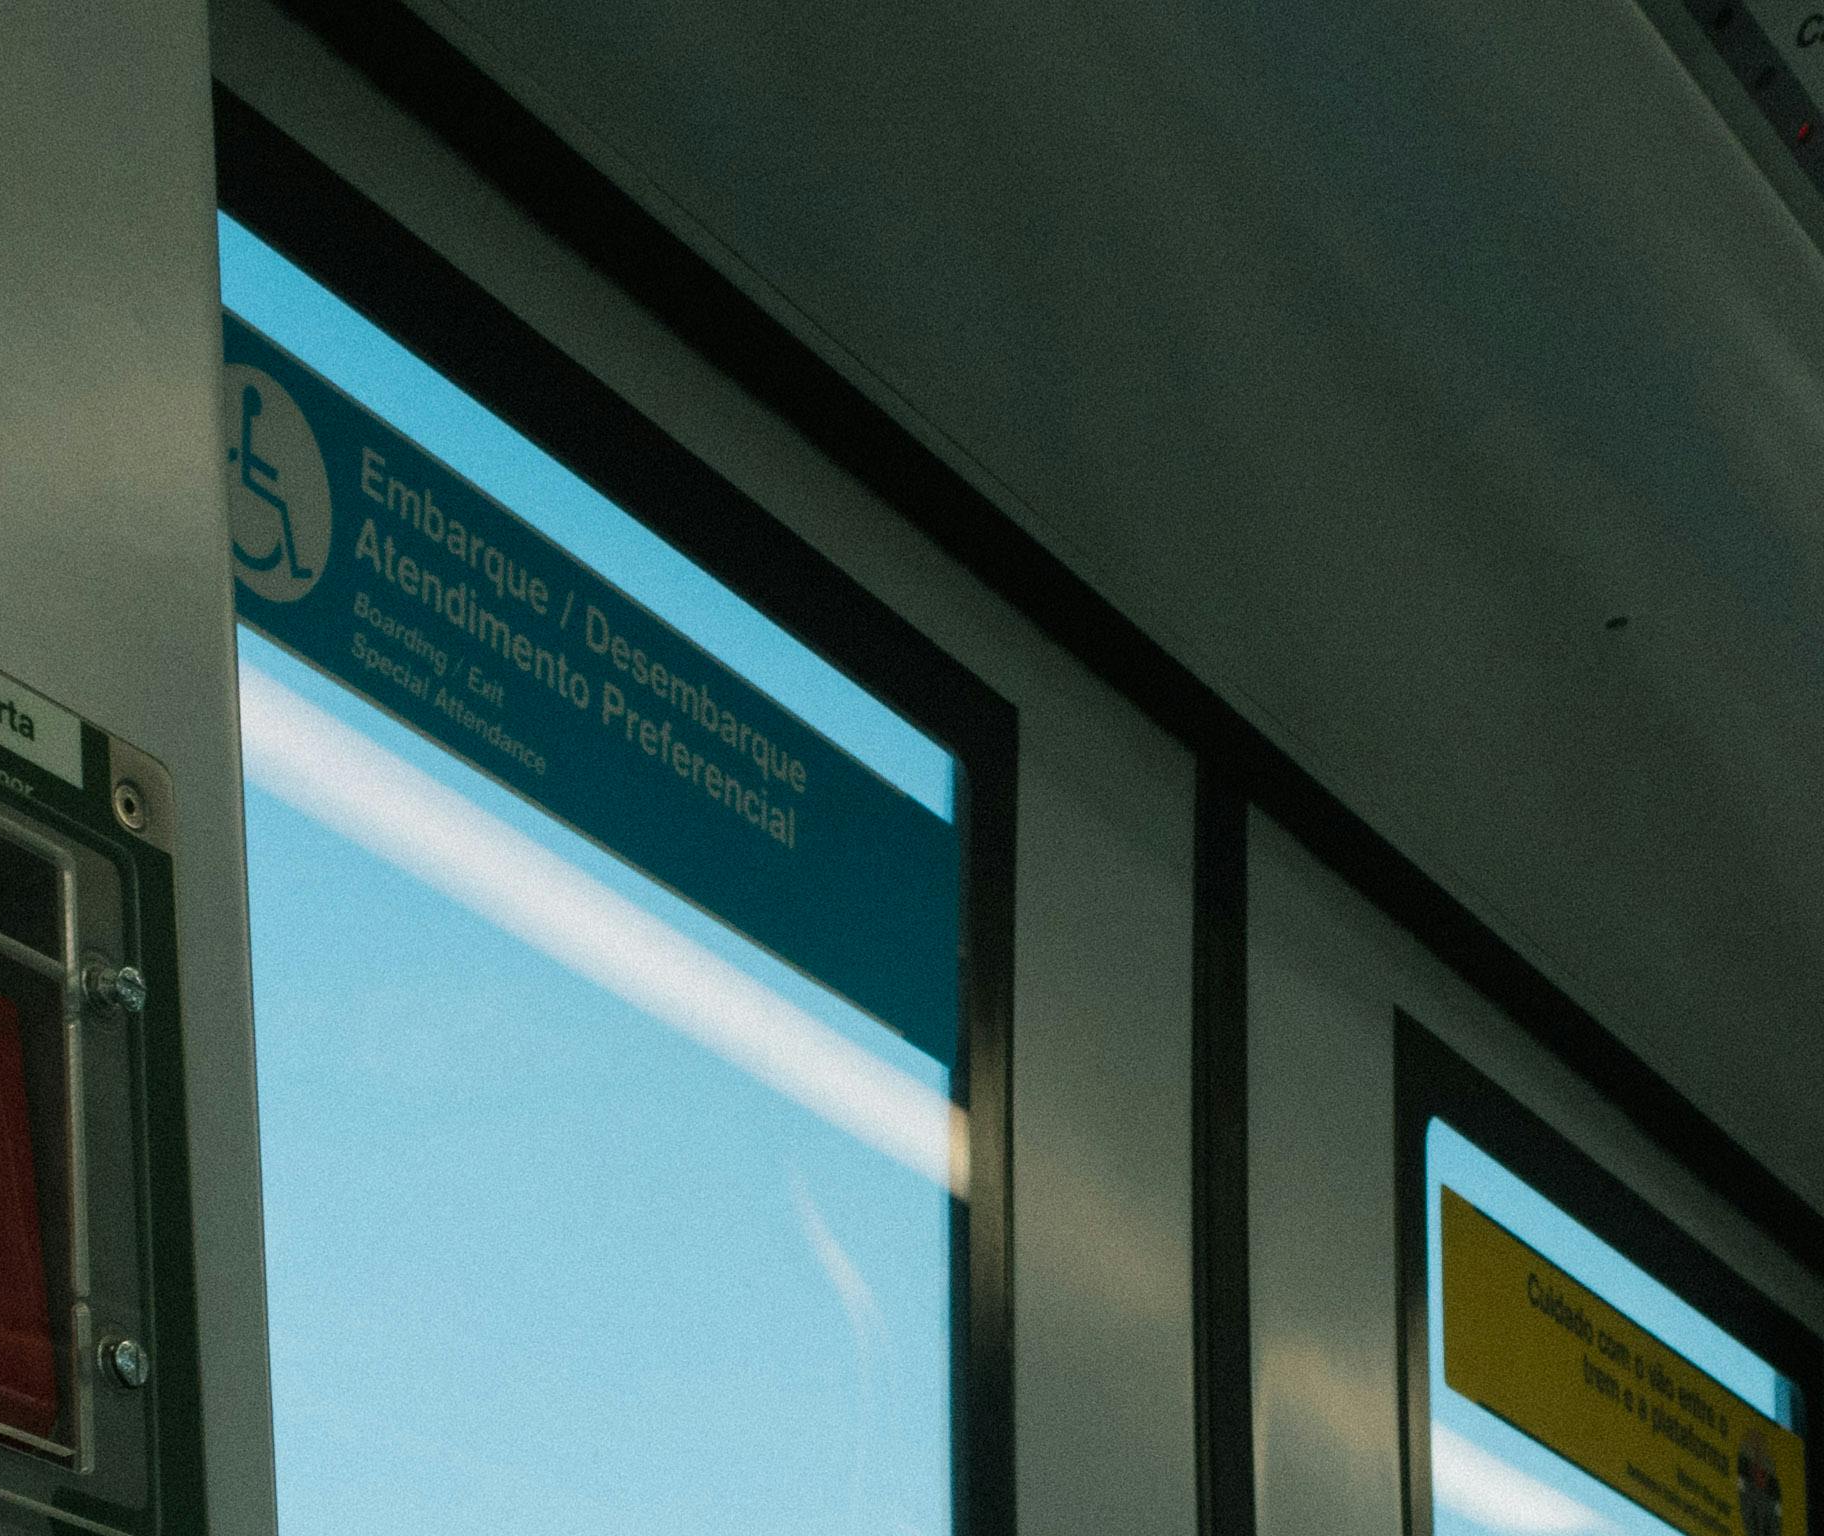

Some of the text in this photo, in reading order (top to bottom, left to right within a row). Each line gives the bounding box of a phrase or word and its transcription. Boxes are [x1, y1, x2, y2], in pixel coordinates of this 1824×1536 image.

[351, 631, 546, 776] Special Attendance
[353, 591, 448, 677] Boarding
[468, 665, 505, 709] Exit
[354, 517, 795, 850] Atendimento Preferencial
[360, 445, 807, 794] Embarque / Desembarque
